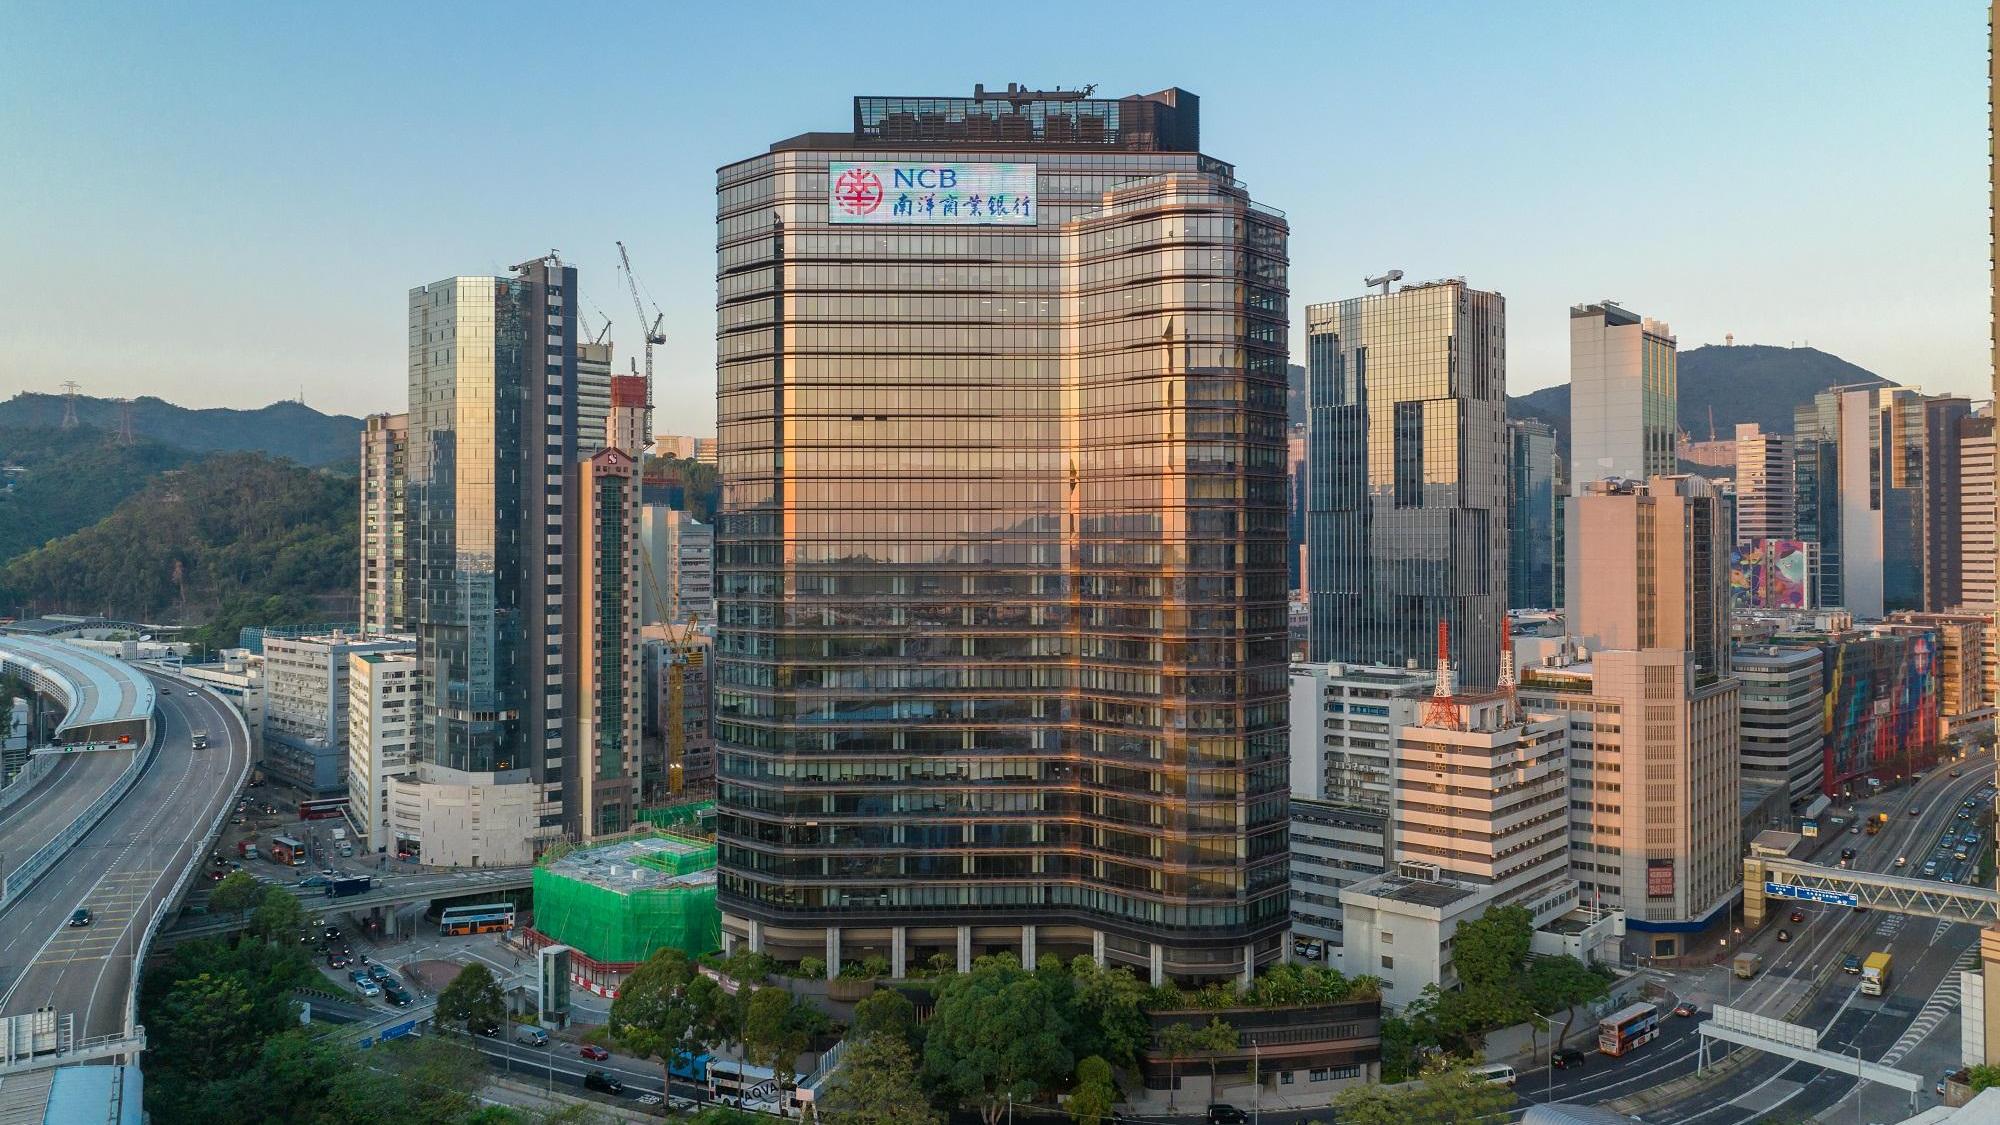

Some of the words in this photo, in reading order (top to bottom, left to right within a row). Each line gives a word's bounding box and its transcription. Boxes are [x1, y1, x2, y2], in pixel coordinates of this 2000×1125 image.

[894, 168, 957, 189] NCB
[893, 192, 1031, 219] 南洋商業銀行
